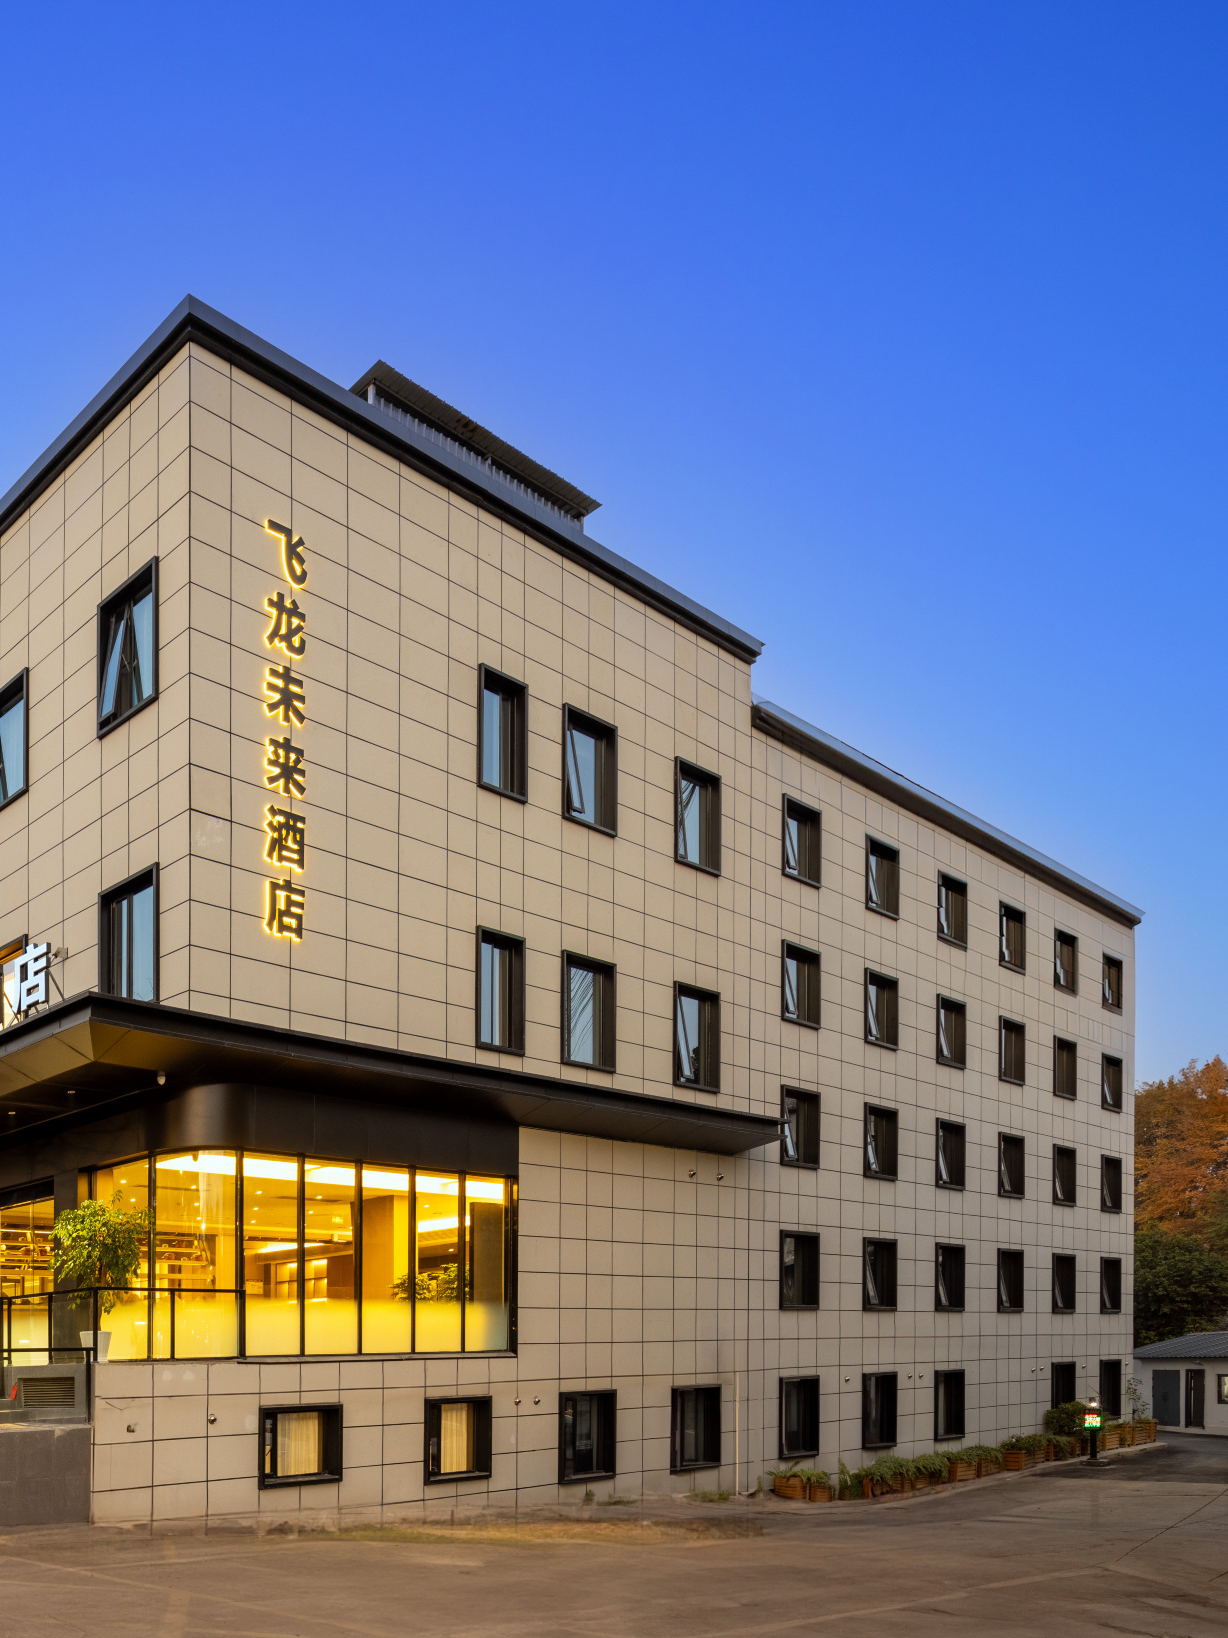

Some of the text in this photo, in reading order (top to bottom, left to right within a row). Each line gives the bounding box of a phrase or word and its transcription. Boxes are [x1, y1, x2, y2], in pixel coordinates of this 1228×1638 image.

[264, 518, 308, 941] 飞龙未来酒店
